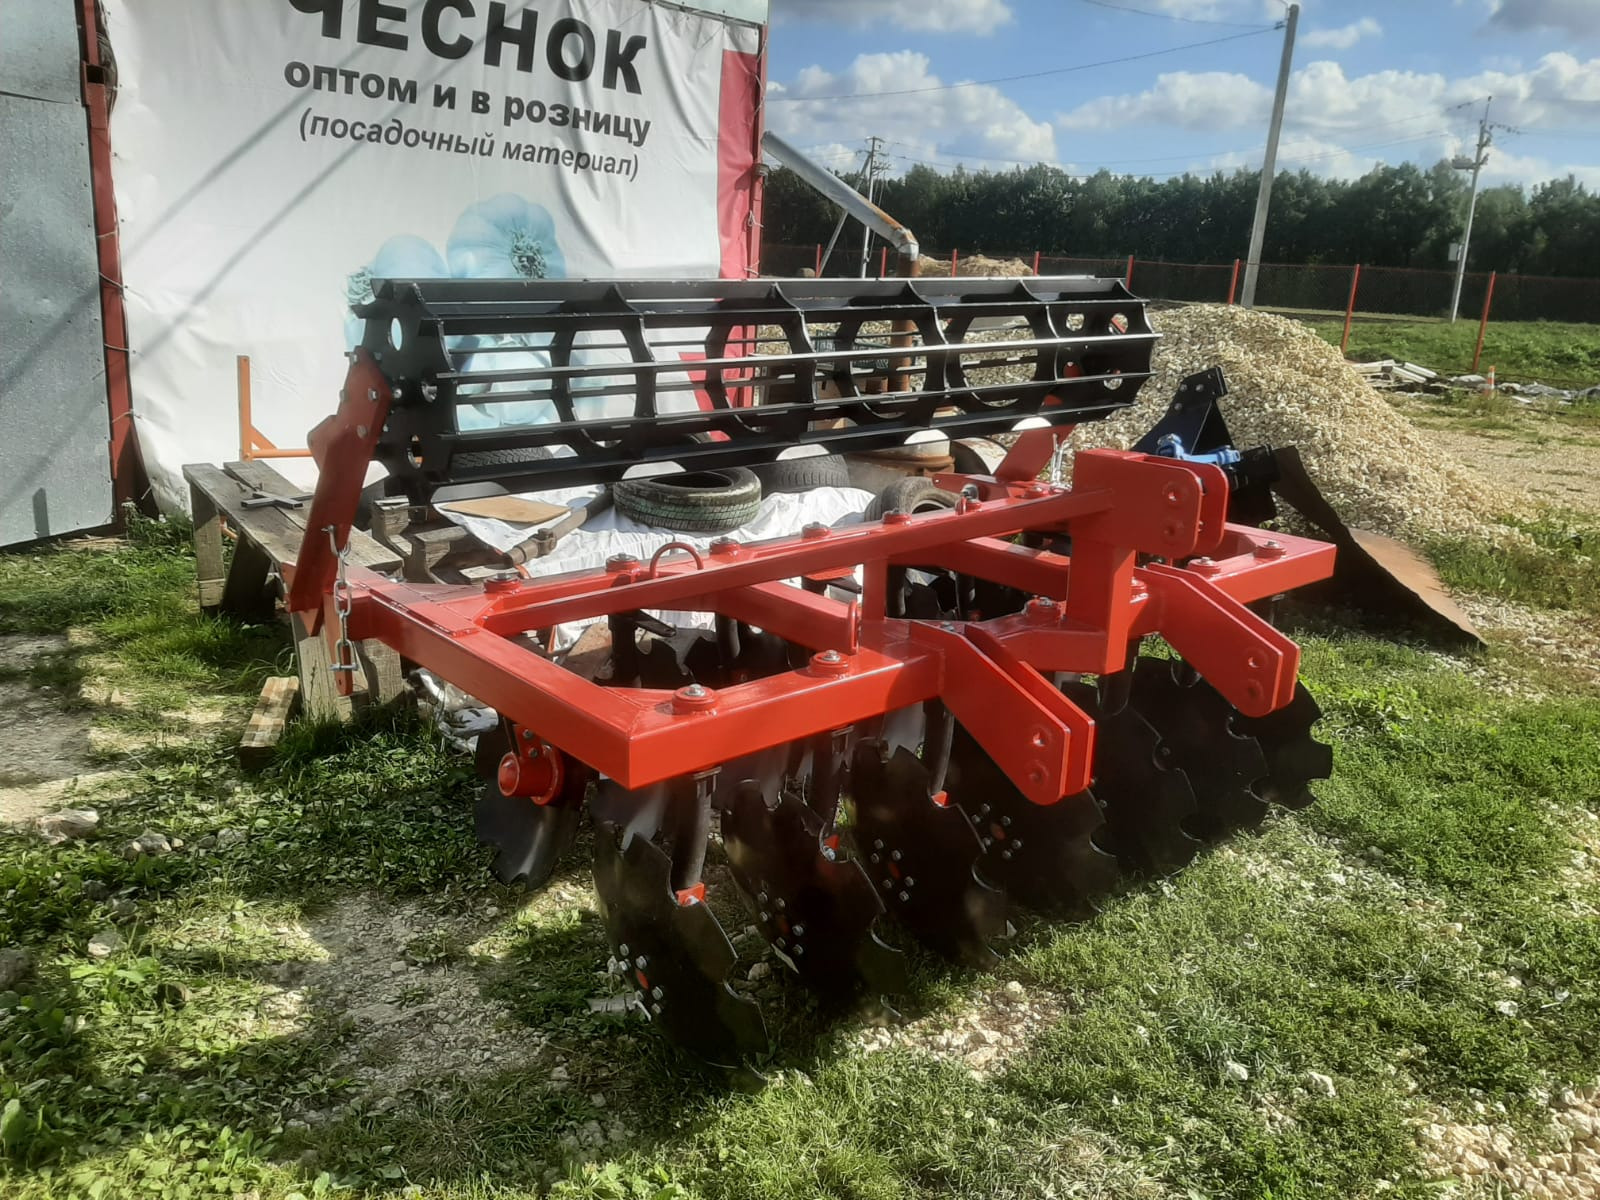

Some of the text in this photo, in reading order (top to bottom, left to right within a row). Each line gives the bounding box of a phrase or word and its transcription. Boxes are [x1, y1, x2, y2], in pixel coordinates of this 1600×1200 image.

[289, 0, 648, 95] ЧЕСНОК
[283, 61, 652, 147] оптом и в розницу
[299, 107, 640, 182] (посадочный материал)
